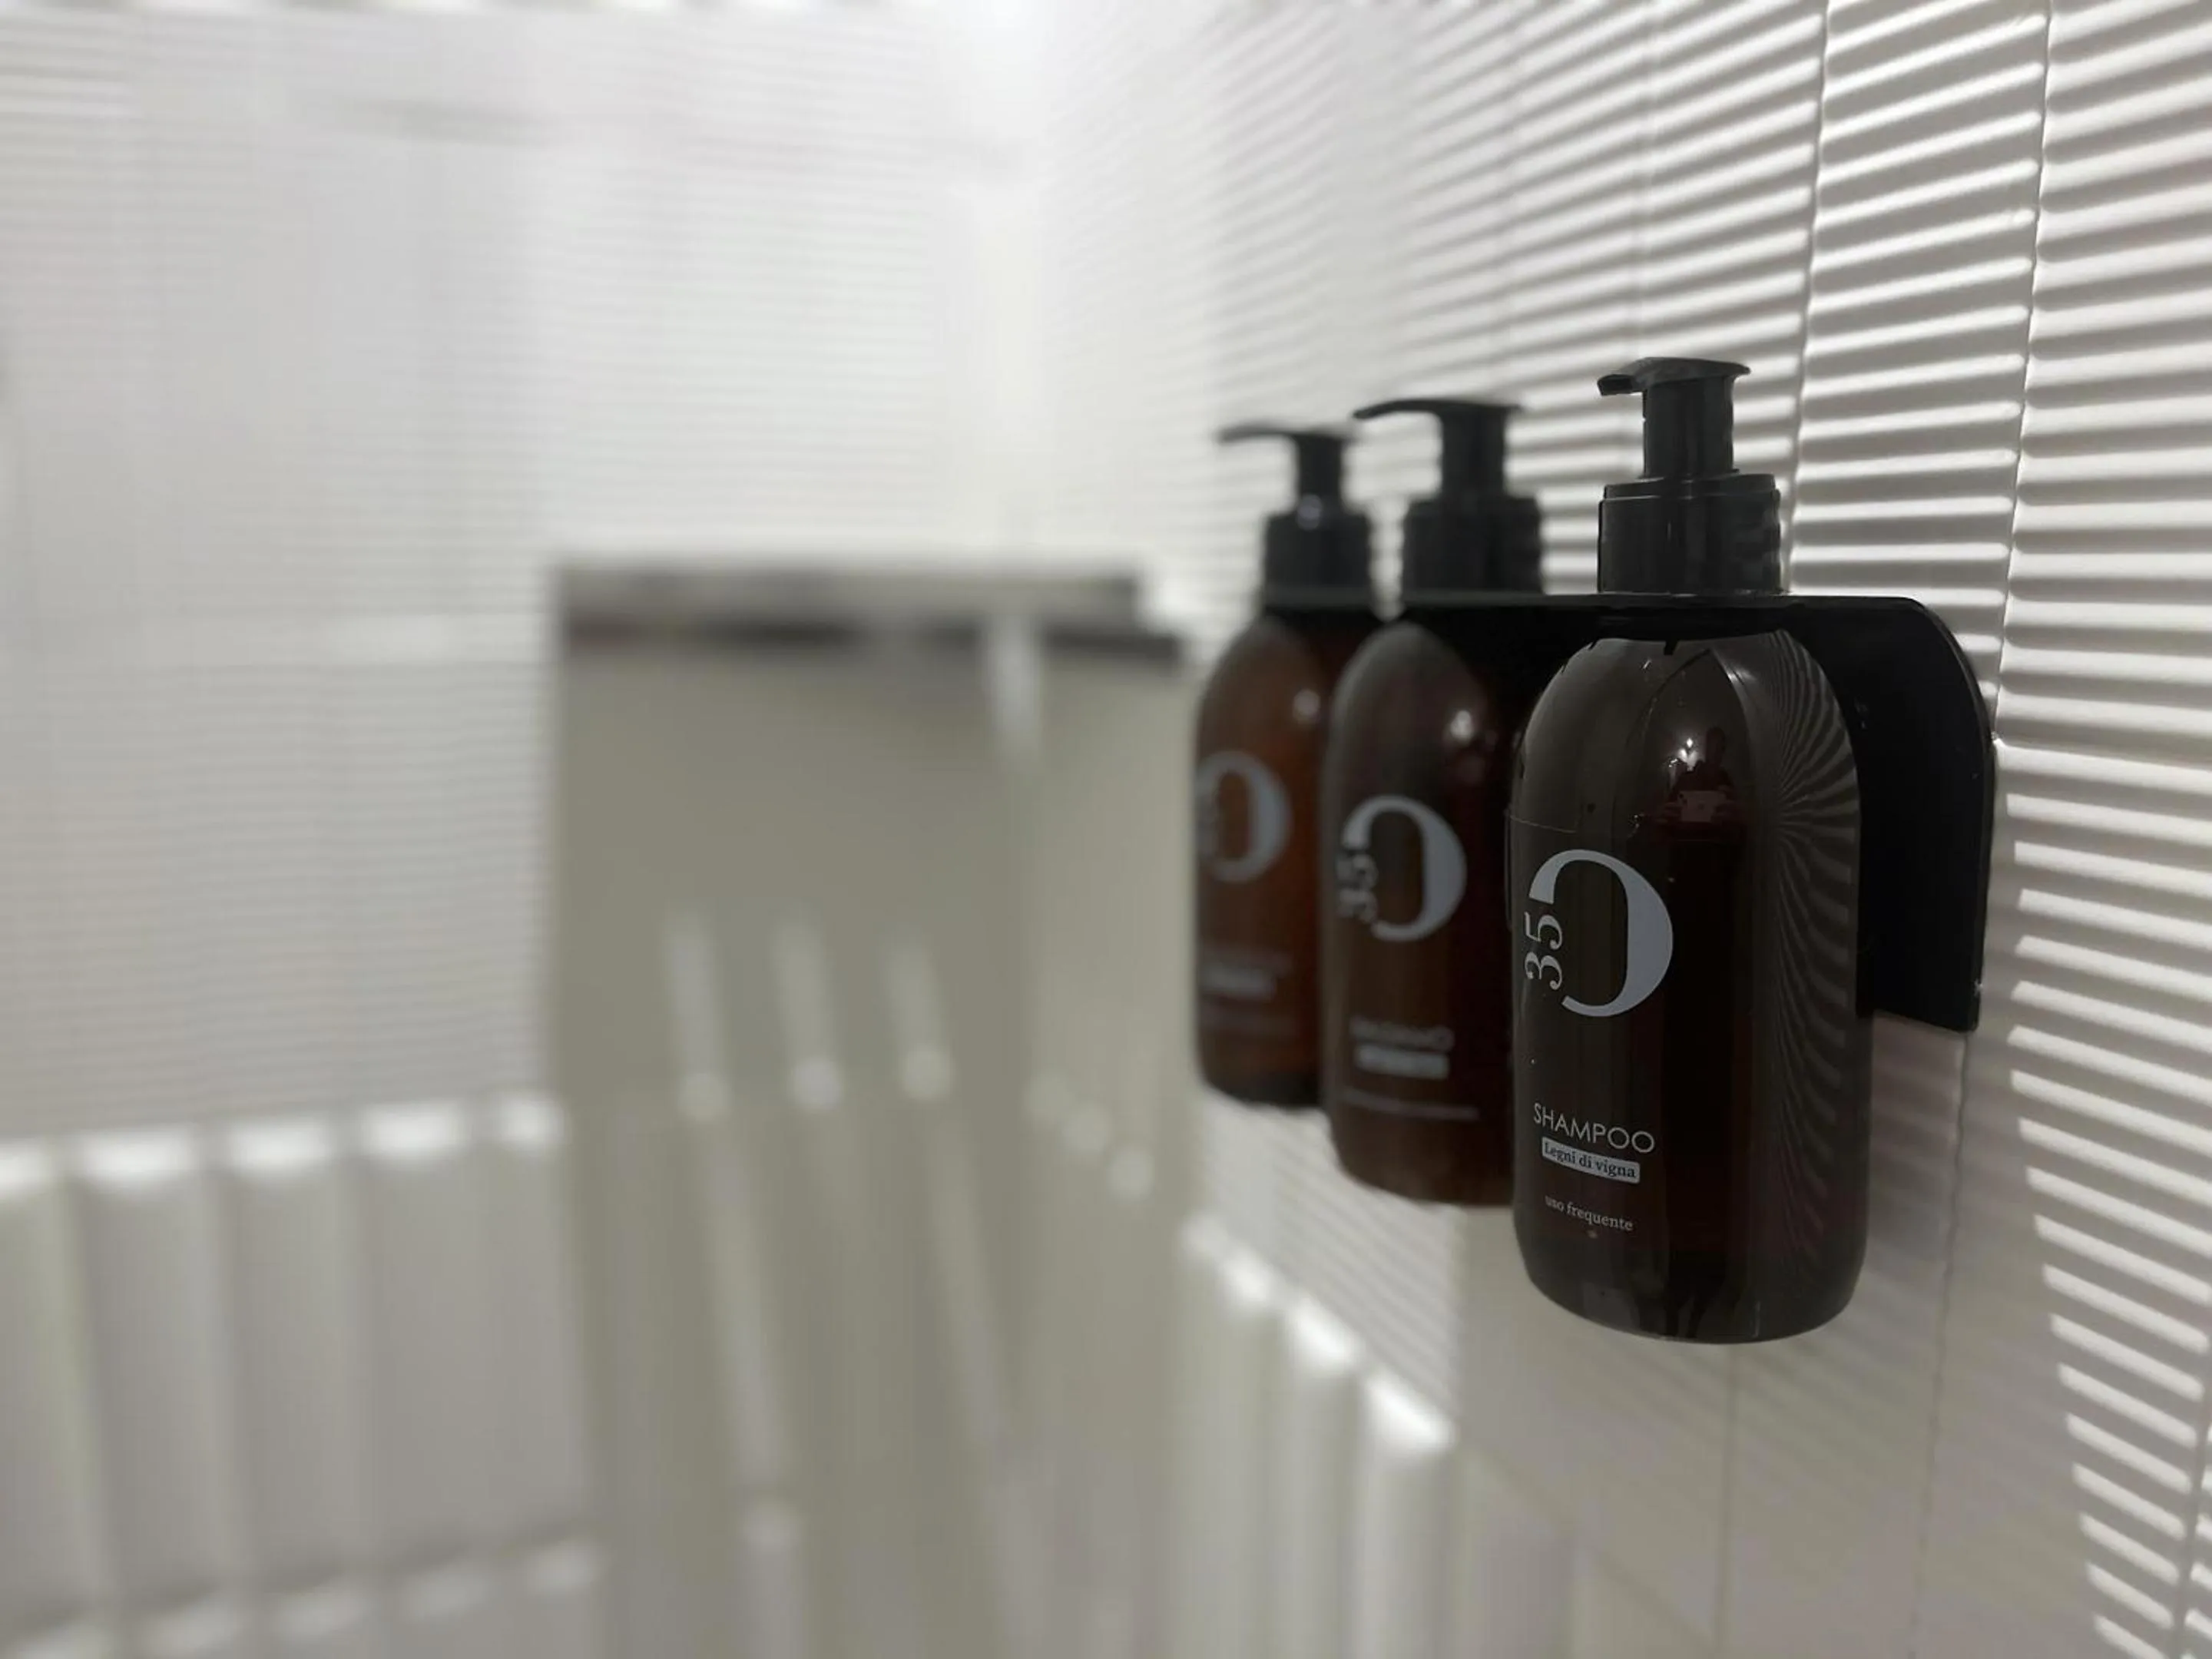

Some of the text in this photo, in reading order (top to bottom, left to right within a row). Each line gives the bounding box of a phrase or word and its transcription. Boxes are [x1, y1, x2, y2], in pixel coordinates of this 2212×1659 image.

[1525, 912, 1562, 990] 35
[1533, 1102, 1655, 1154] SHAMPOO
[1544, 1141, 1636, 1178] Legni di vigna
[1545, 1195, 1634, 1231] uso frequente
